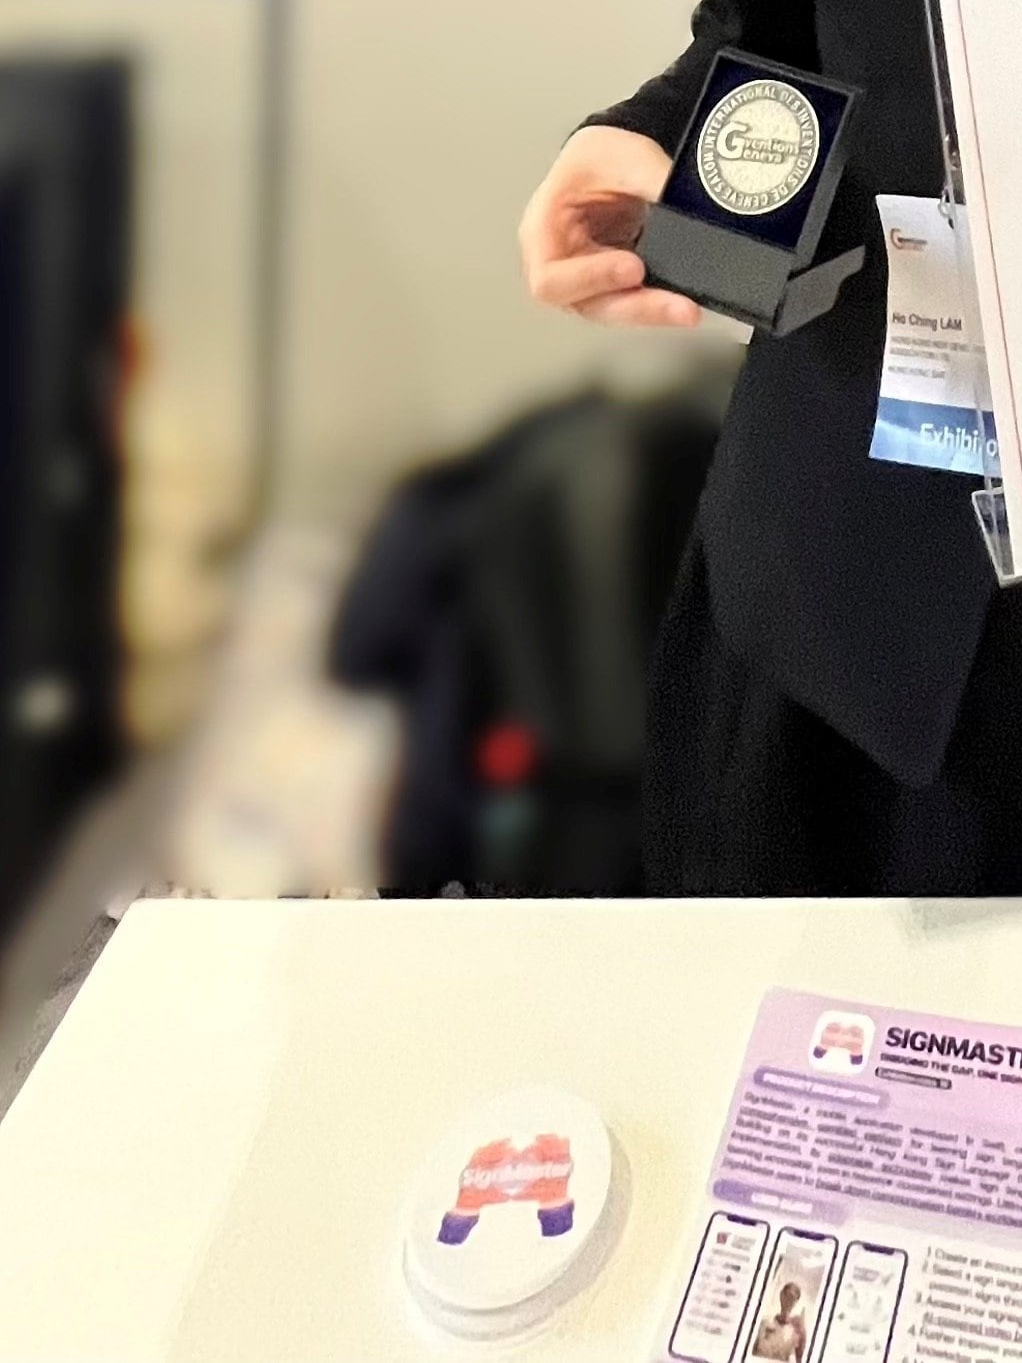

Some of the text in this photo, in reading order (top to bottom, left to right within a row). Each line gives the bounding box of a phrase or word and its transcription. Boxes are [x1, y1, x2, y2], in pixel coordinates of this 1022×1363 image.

[704, 85, 776, 148] INTERNATIONAL
[892, 312, 962, 332] Ho Ching LAM
[919, 423, 1000, 457] Exhibio
